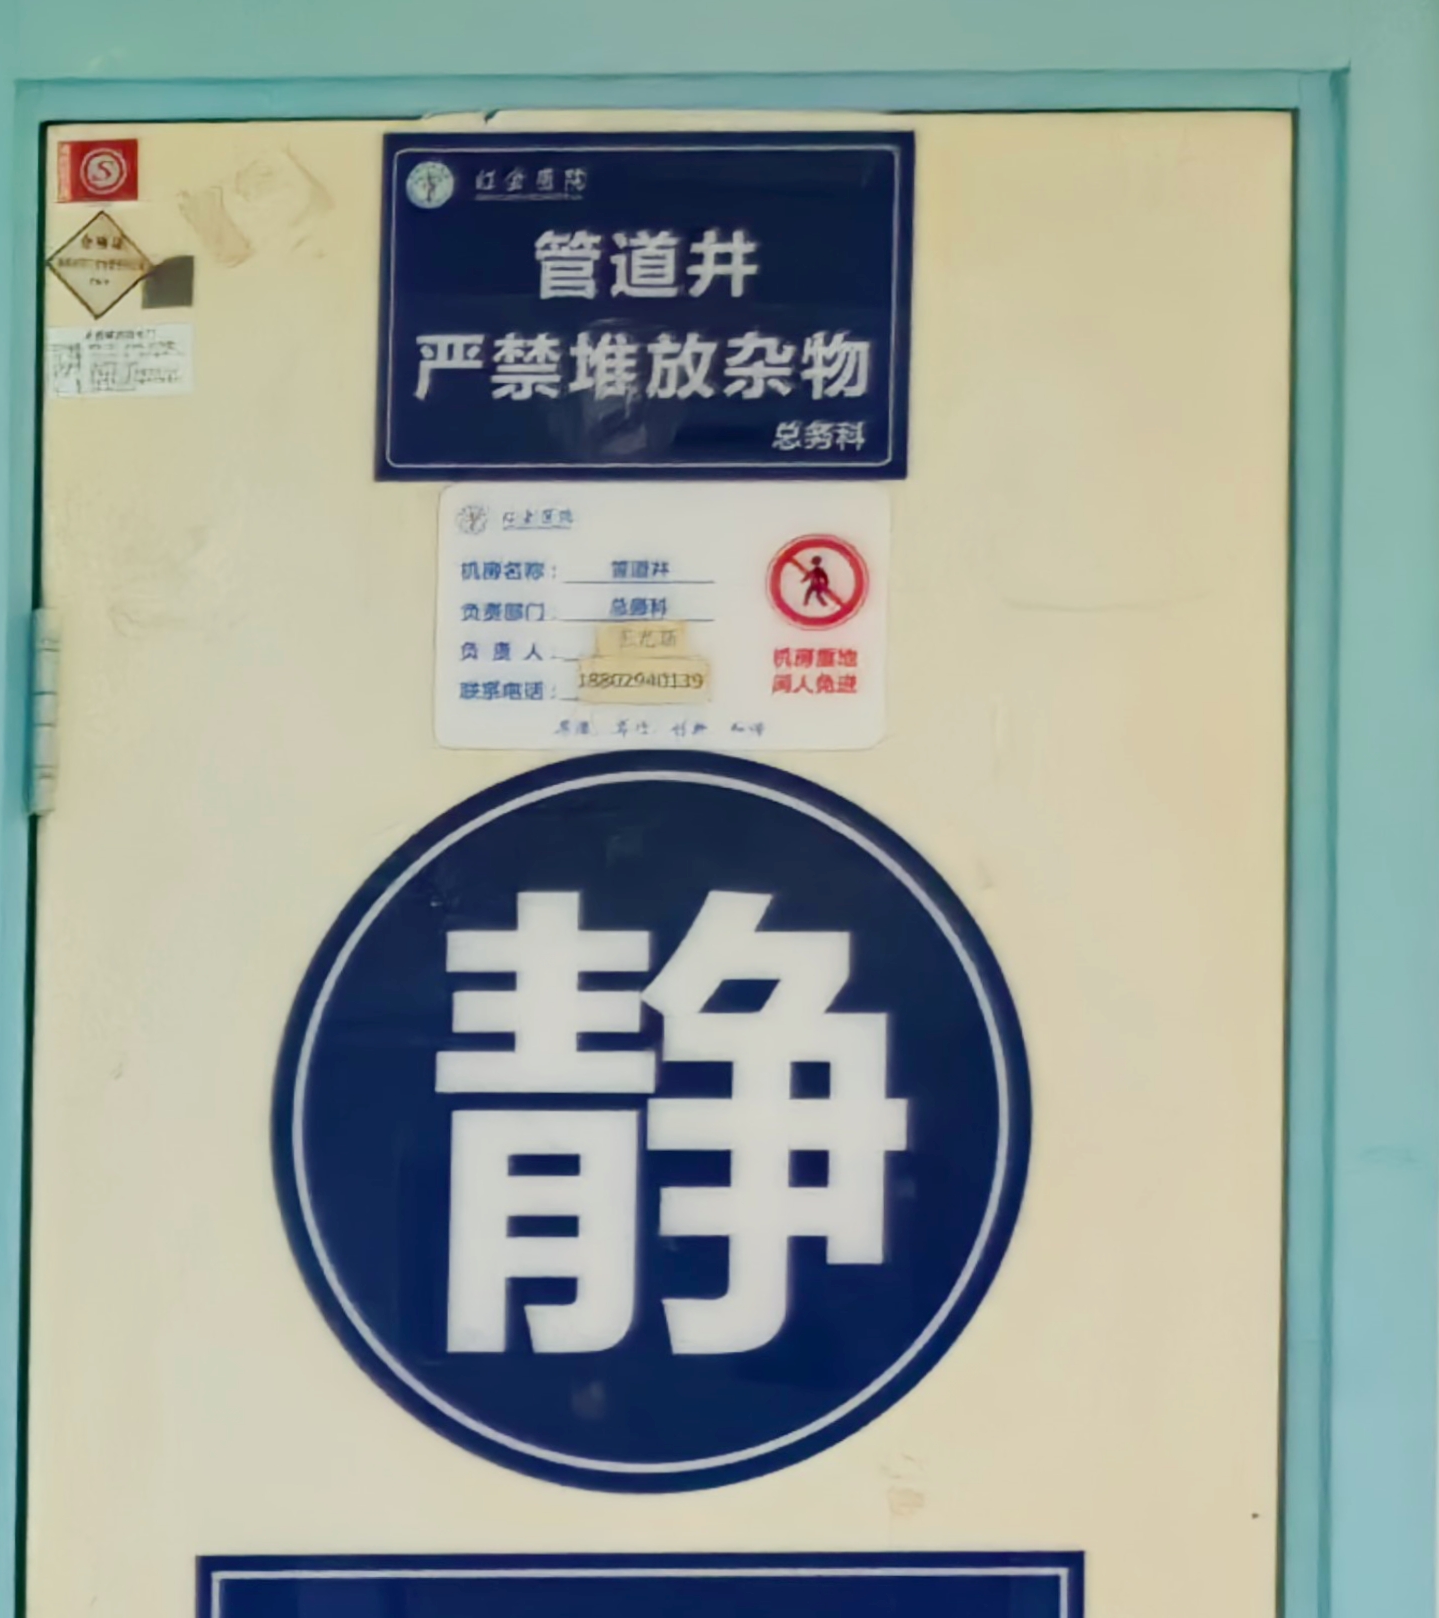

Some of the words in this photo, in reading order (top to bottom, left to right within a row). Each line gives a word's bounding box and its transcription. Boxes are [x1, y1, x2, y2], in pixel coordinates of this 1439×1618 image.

[534, 229, 760, 300] 管道井
[414, 330, 871, 400] 严禁堆放杂物
[772, 420, 865, 450] 总务科
[435, 890, 908, 1355] 静
